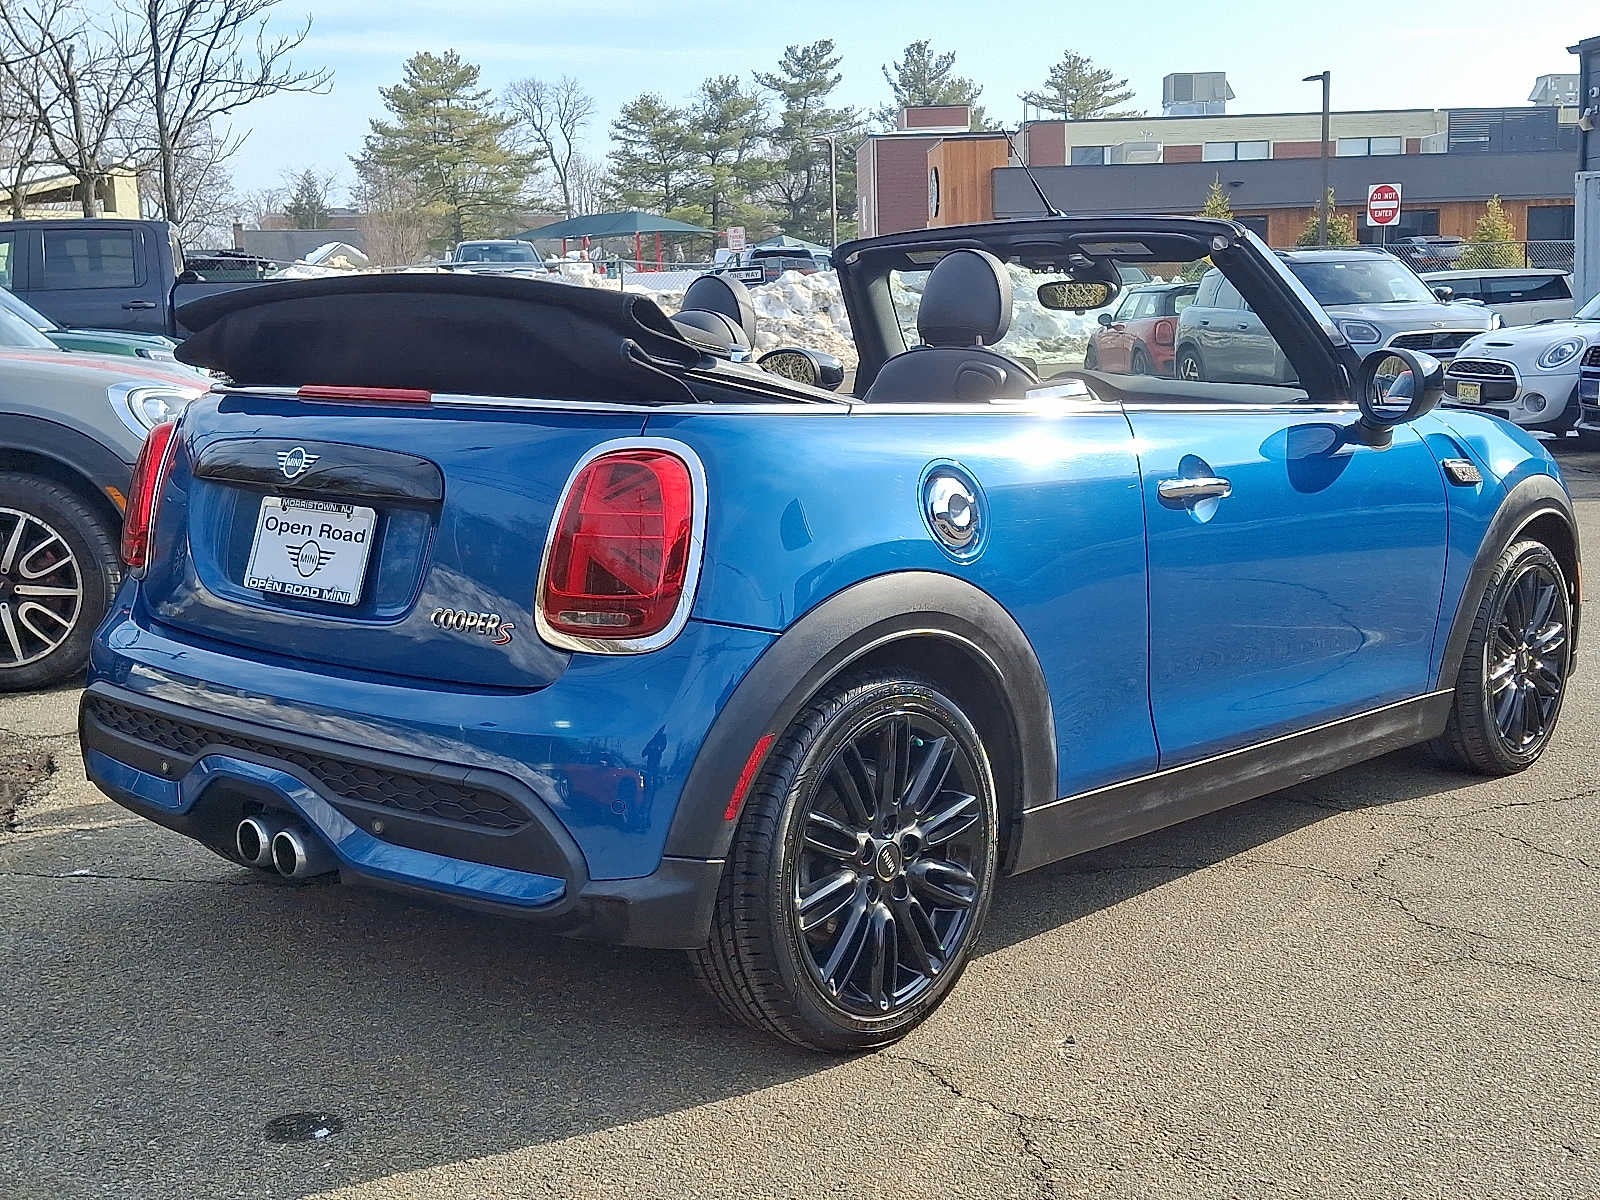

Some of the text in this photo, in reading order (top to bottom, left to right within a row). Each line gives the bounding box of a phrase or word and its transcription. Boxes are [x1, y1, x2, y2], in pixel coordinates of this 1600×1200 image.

[1373, 192, 1396, 200] DO NOT
[1374, 209, 1393, 218] ENTER
[730, 271, 759, 280] ONE WAY
[286, 457, 302, 467] MINI
[340, 504, 353, 515] NJ
[265, 516, 366, 543] Open Road
[300, 553, 318, 565] MINI
[249, 577, 352, 603] OPEN ROAD MINI
[881, 849, 896, 873] MINI
